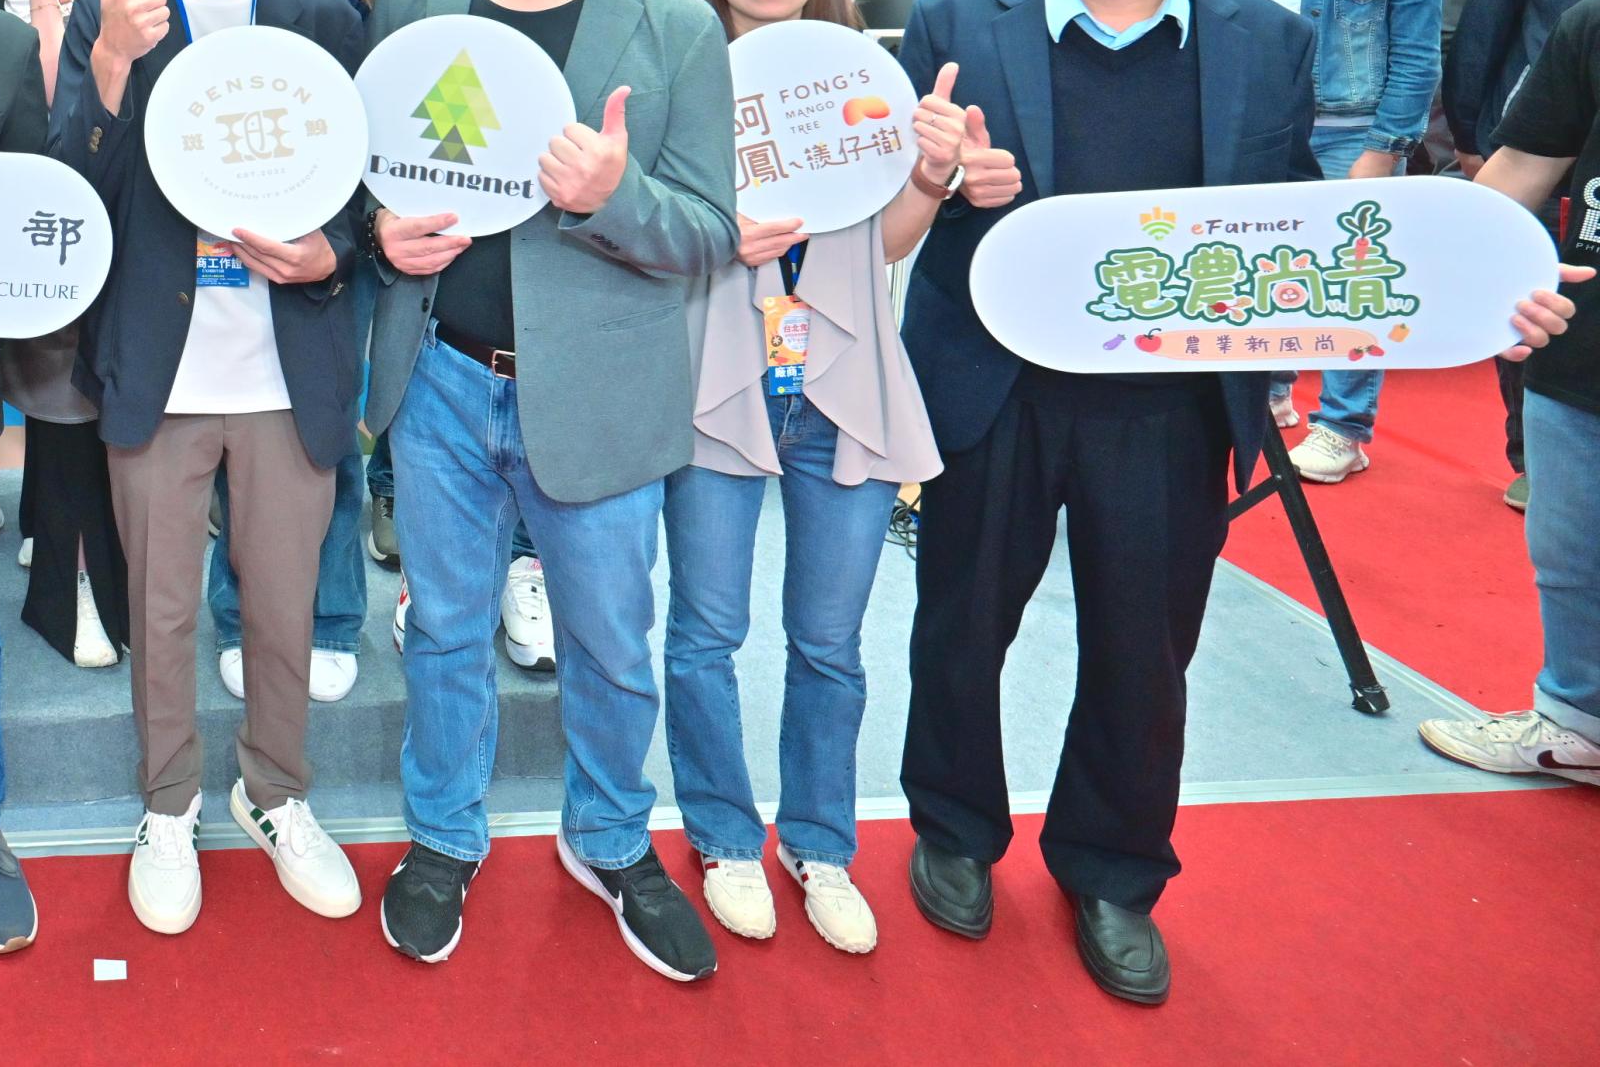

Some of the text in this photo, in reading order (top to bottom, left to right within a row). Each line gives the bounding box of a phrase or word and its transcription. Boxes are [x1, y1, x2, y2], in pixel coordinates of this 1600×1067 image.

[188, 75, 312, 118] BENSON
[779, 69, 871, 104] FONG'S
[785, 99, 836, 121] MANGO
[790, 120, 821, 135] TREE
[370, 154, 535, 200] Danongnet
[1190, 216, 1305, 235] eFarmer
[1088, 240, 1418, 325] 電農尚青
[1185, 335, 1335, 355] 農業新風尚
